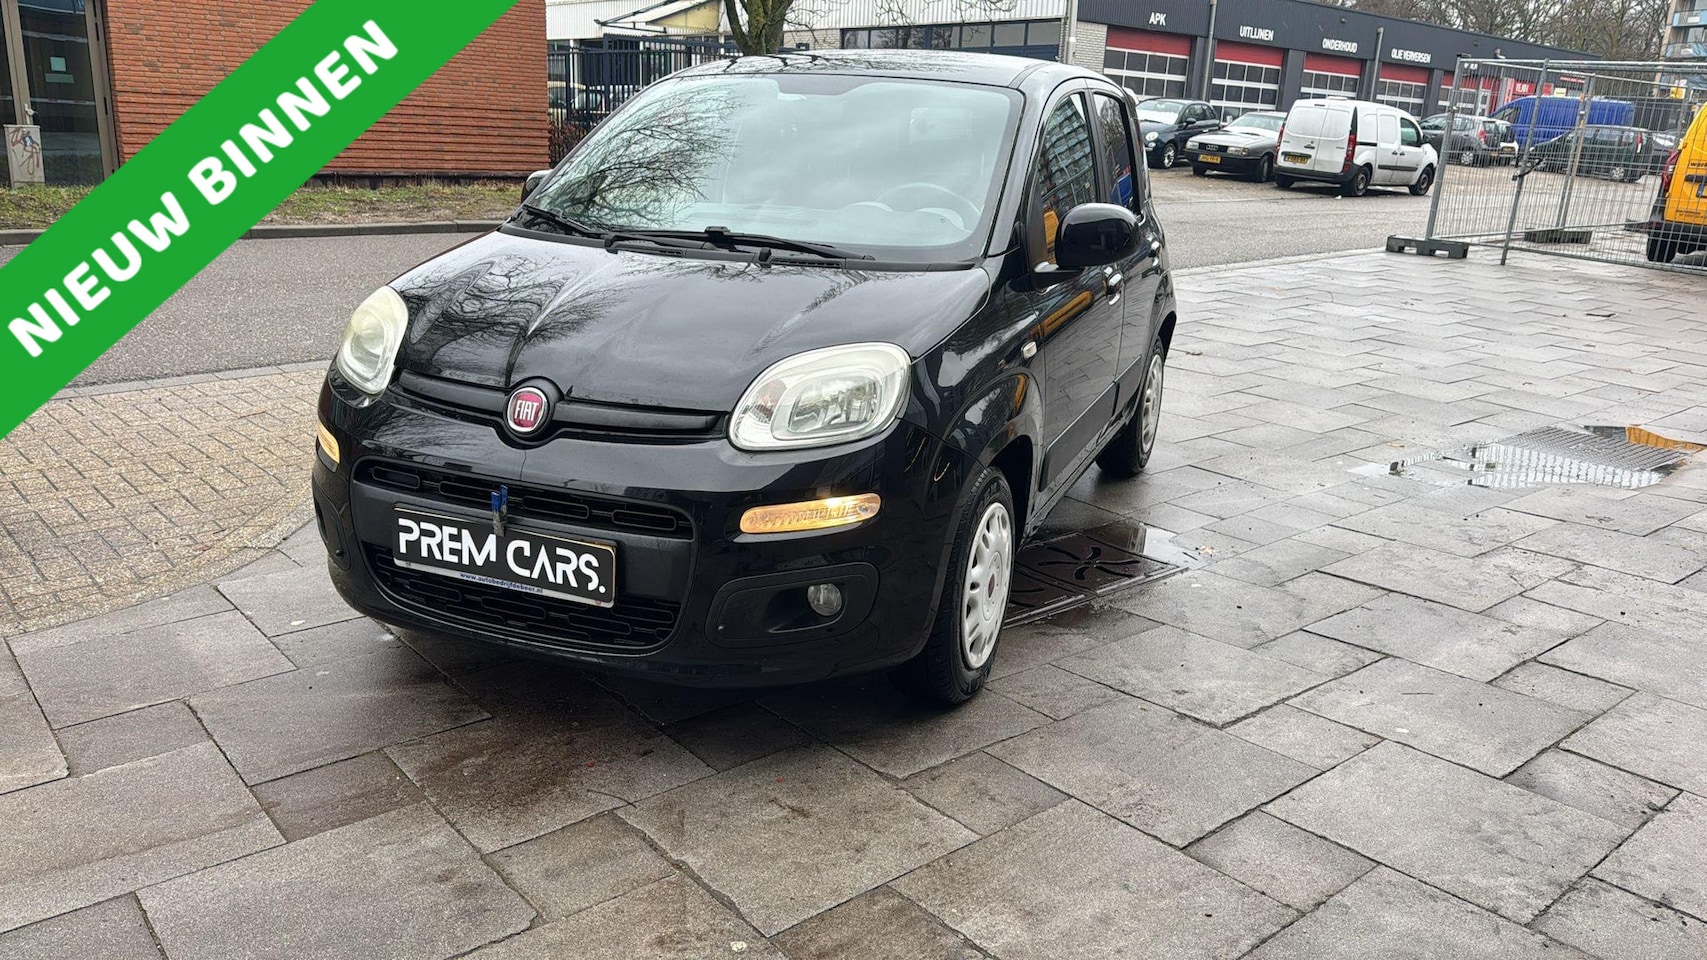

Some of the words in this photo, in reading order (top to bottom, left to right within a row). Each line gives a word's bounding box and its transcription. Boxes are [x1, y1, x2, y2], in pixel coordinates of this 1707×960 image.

[1149, 12, 1166, 26] APK
[1239, 25, 1274, 41] UITLIJNEN
[1322, 38, 1358, 53] ONDERHOUD
[514, 399, 539, 422] FIAT
[398, 518, 497, 566] PREM
[506, 540, 606, 593] CARS.
